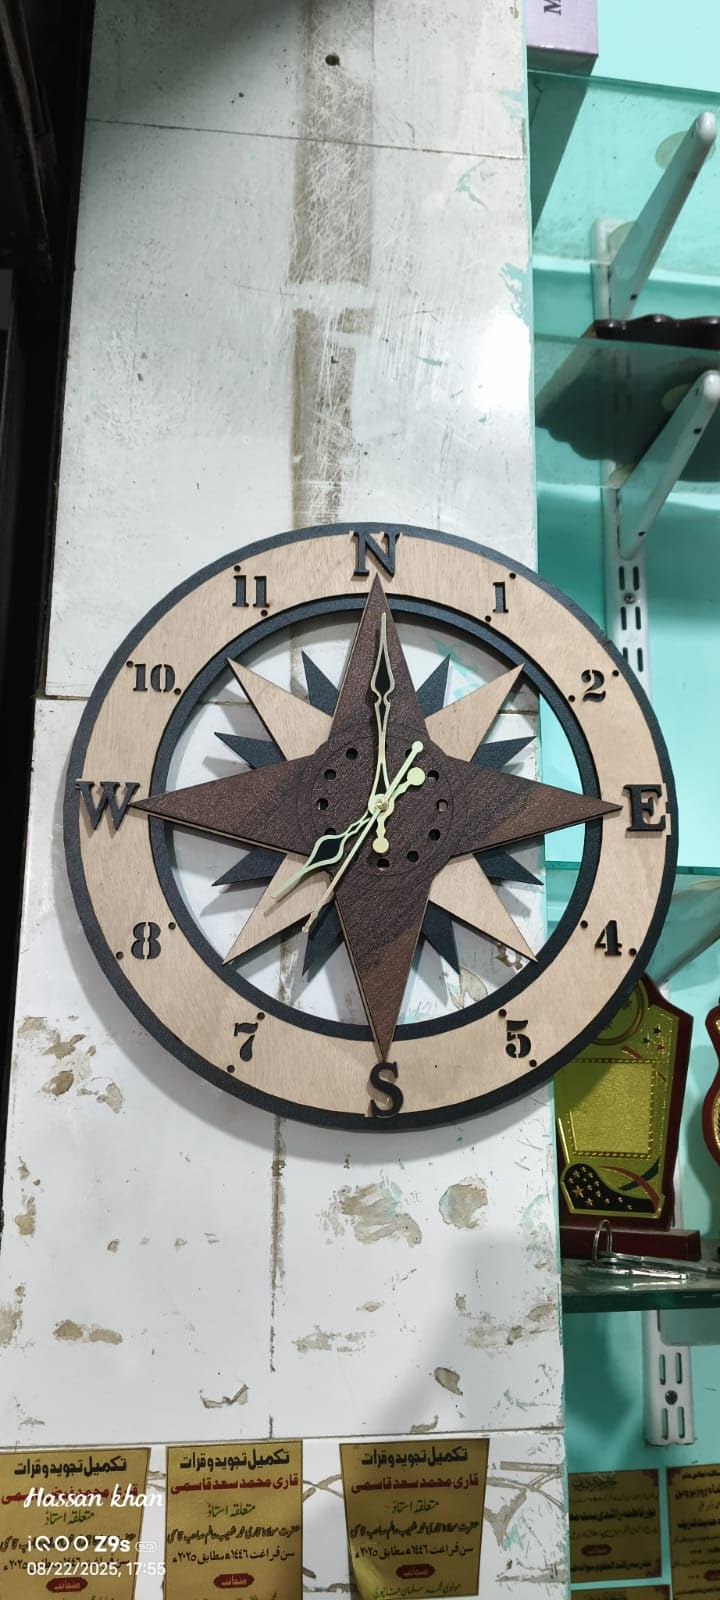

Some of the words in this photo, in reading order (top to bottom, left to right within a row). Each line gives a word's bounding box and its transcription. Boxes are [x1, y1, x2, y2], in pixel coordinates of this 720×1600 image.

[352, 530, 400, 577] N
[233, 574, 269, 609] 11
[493, 581, 509, 614] 1
[132, 663, 175, 693] 10
[581, 669, 606, 701] 2
[76, 781, 140, 830] W
[623, 783, 670, 832] E
[131, 921, 161, 960] 8
[594, 926, 622, 956] 4
[234, 1021, 259, 1062] 7
[506, 1019, 532, 1059] 5
[369, 1061, 404, 1118] S
[248, 1448, 289, 1470] تکمیل
[428, 1446, 468, 1466] تکمیل
